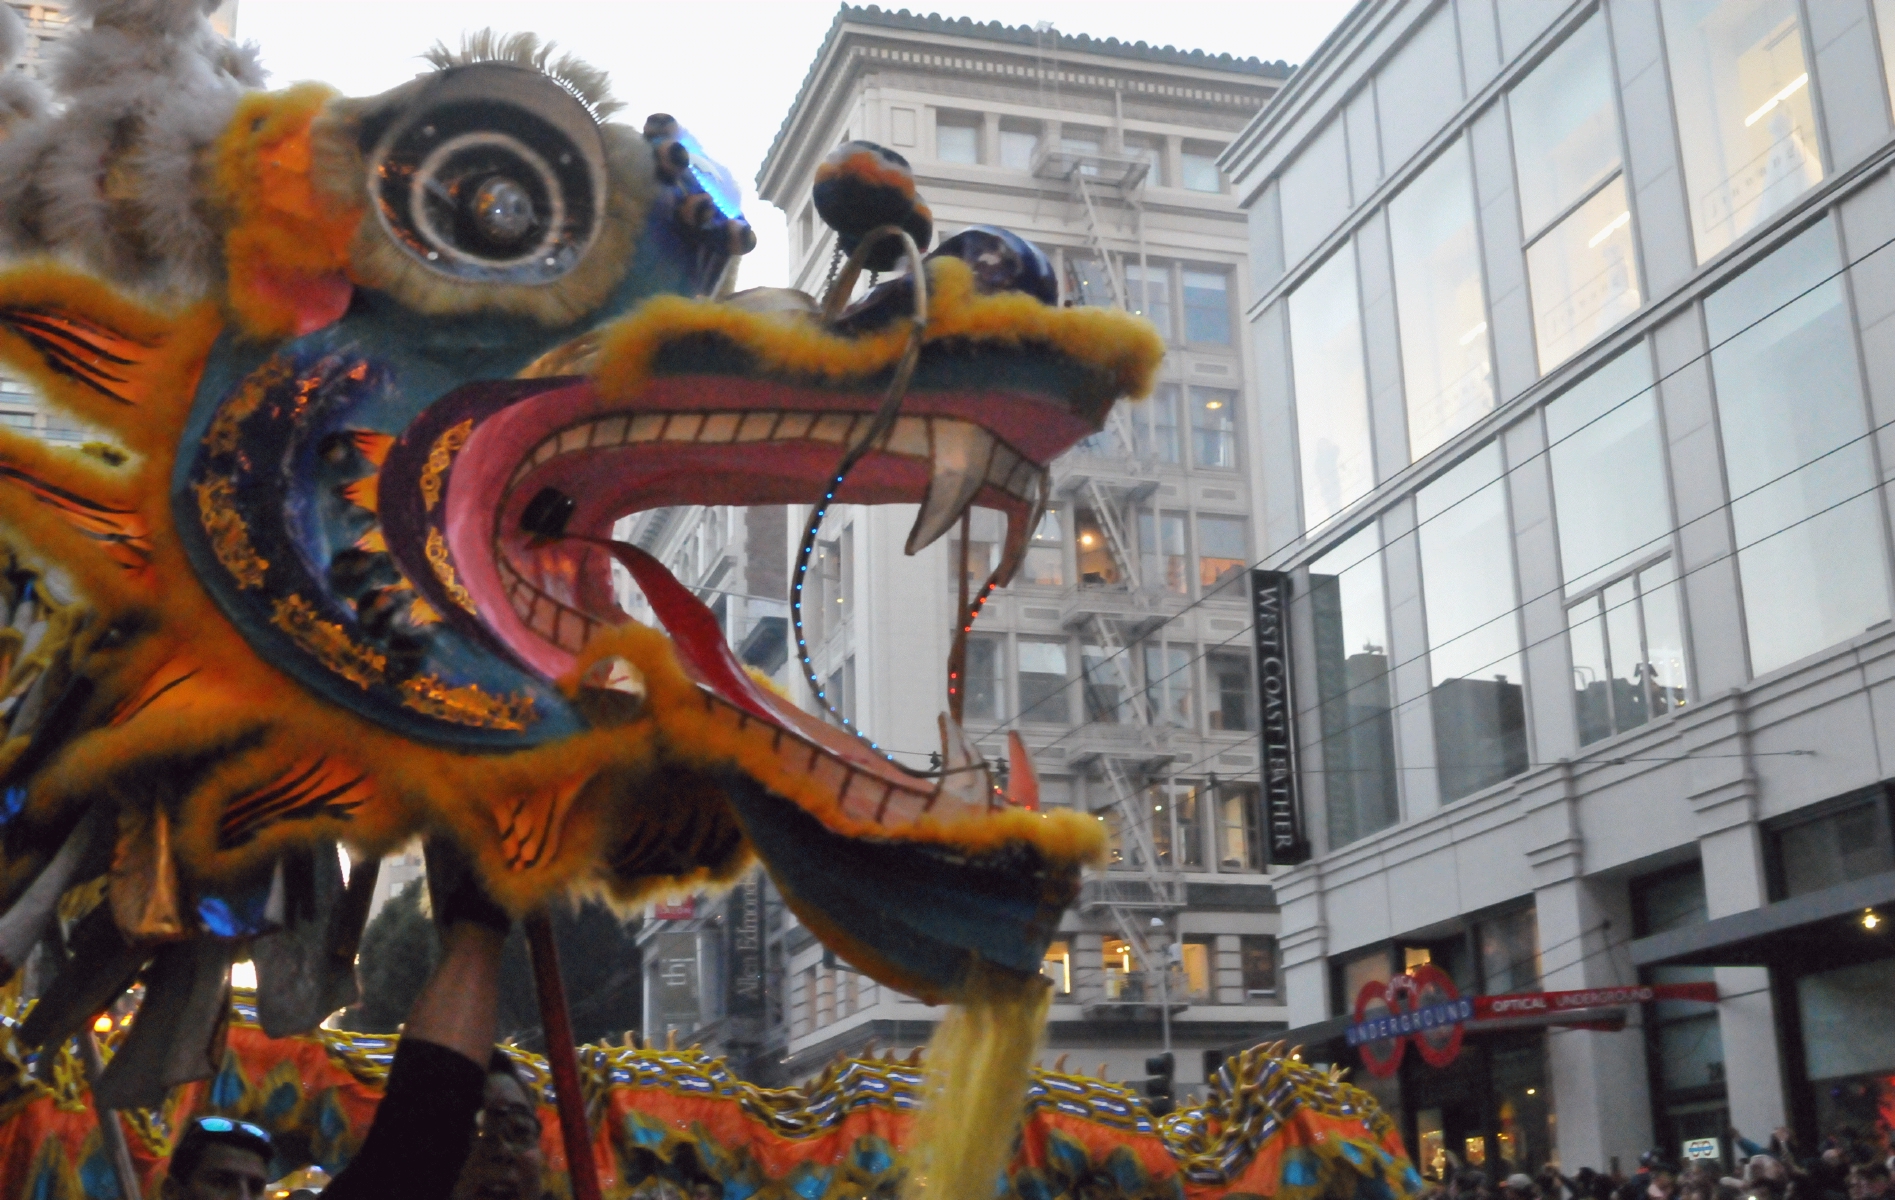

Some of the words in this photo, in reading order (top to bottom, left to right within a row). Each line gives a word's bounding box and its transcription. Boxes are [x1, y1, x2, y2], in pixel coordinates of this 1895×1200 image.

[1258, 587, 1280, 651] WEST
[1262, 657, 1284, 738] COAST
[1268, 744, 1293, 850] LEATHER
[737, 956, 759, 999] Allen
[1492, 998, 1546, 1012] OPTICAL
[1557, 988, 1653, 1007] UNDERGROUND
[1348, 1000, 1470, 1044] UNDERGROUND
